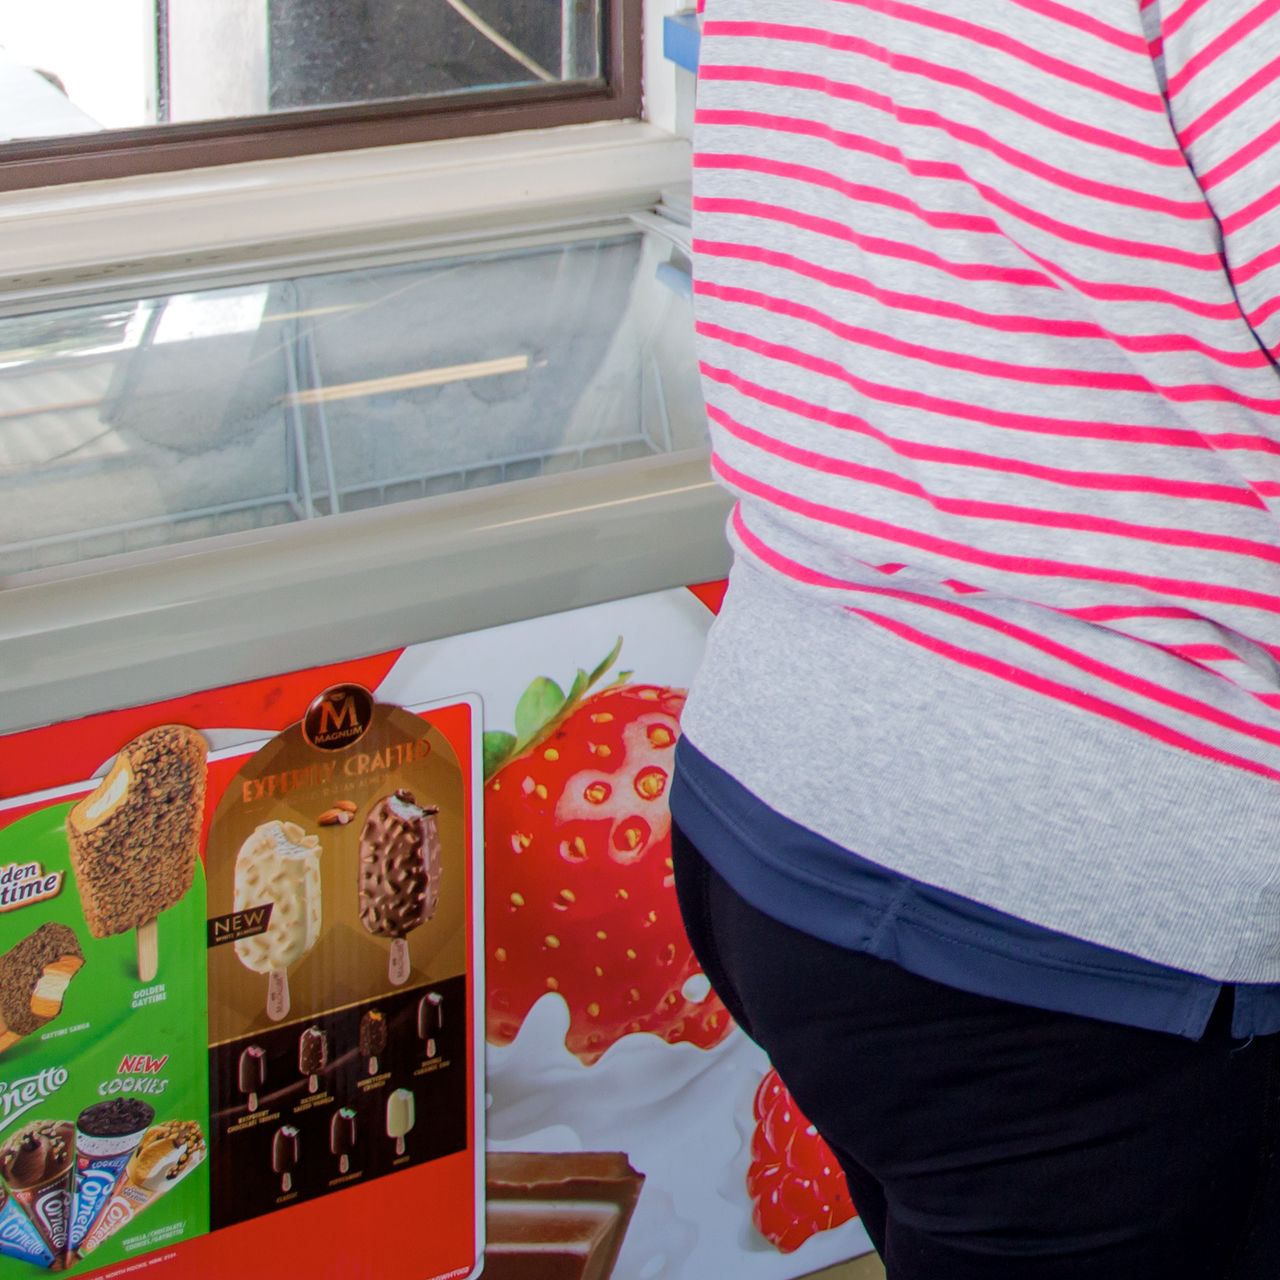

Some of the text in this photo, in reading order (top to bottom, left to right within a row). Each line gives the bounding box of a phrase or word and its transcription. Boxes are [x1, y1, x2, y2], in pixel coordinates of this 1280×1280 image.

[319, 695, 360, 734] M
[315, 725, 364, 744] MAGNUM
[344, 739, 432, 776] CRAFTED
[215, 909, 266, 937] NEW
[131, 992, 166, 1008] GAYTIME
[133, 984, 165, 999] GOLDEN
[117, 1055, 169, 1075] NEW
[98, 1078, 168, 1096] COOKIES
[92, 1159, 125, 1170] COOKIES
[71, 1169, 115, 1244] Cornetto
[36, 1189, 71, 1249] Cornetto
